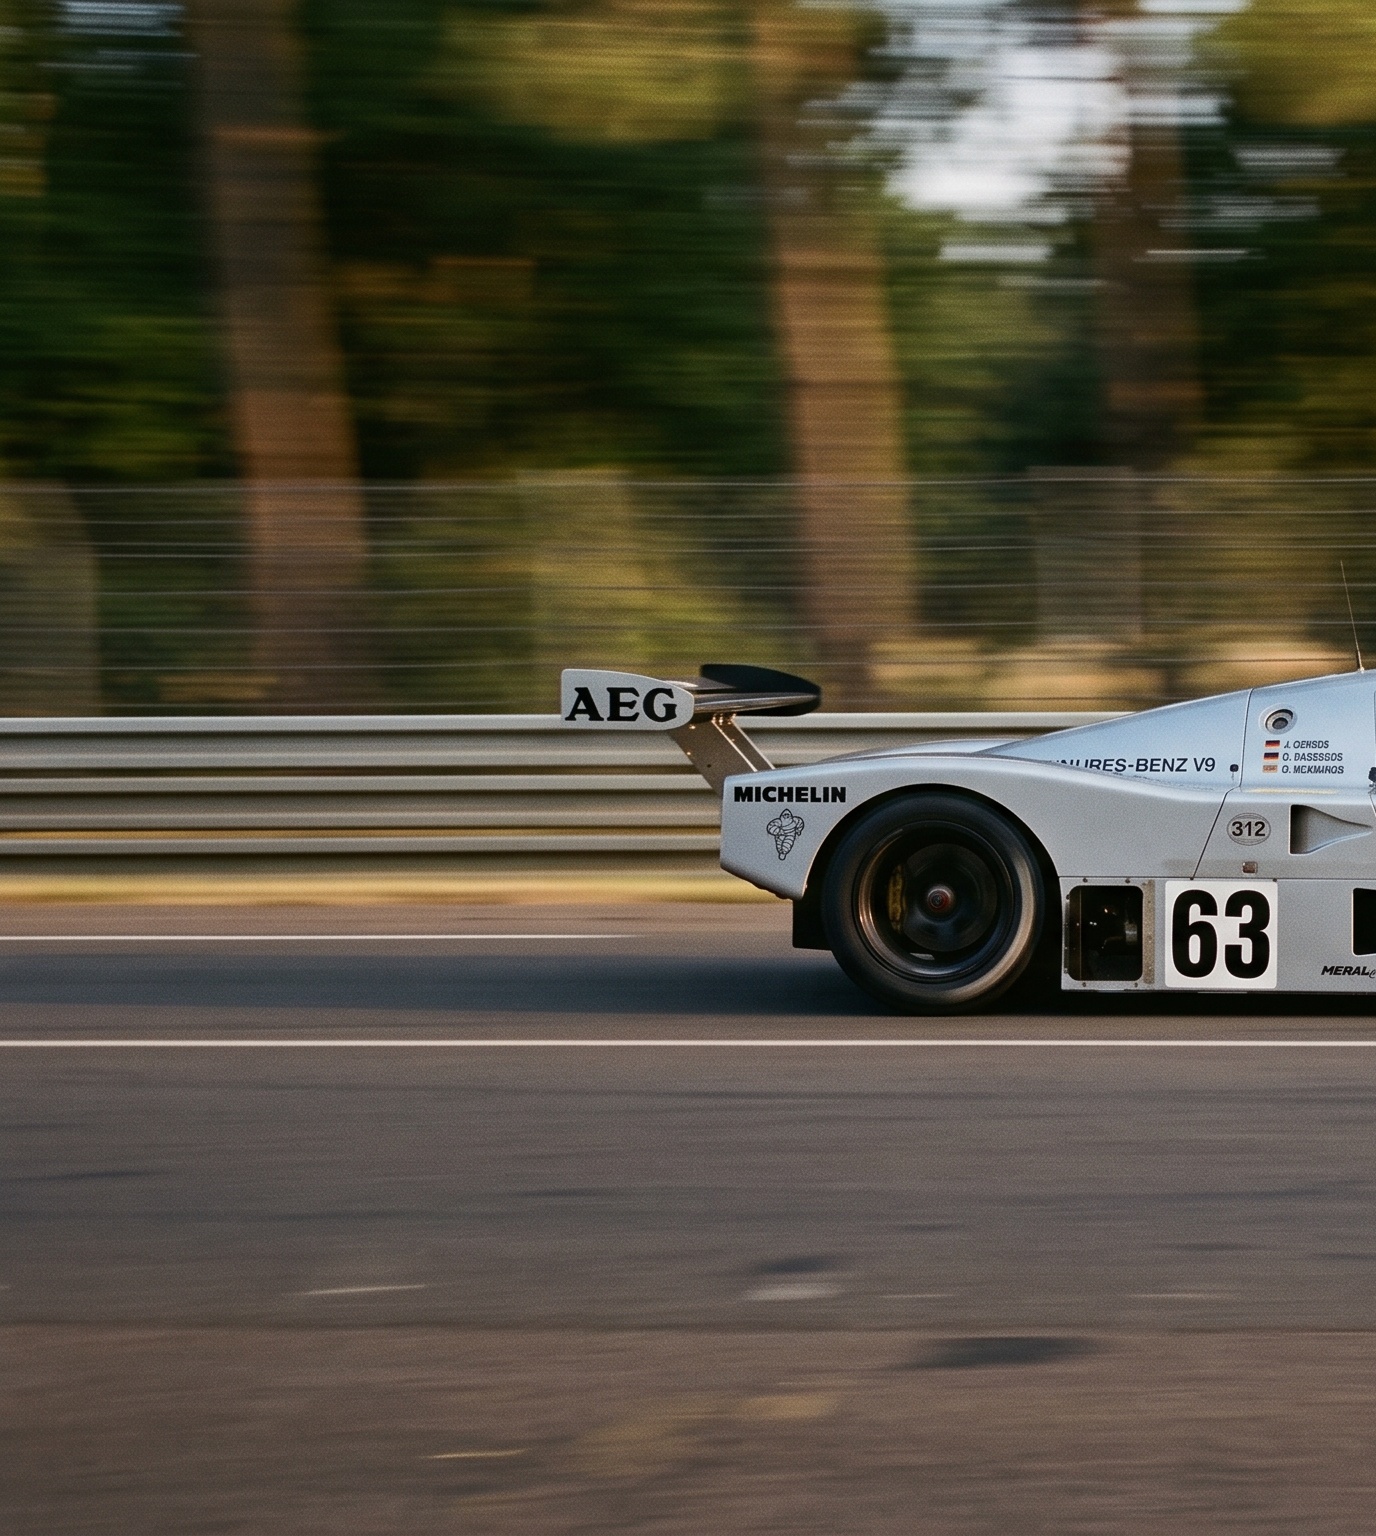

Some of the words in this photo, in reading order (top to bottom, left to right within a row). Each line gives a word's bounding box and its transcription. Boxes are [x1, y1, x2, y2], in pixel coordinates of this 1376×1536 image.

[564, 686, 678, 723] AEG
[1193, 757, 1216, 772] V9
[733, 786, 847, 803] MICHELIN
[1231, 821, 1266, 837] 312
[1172, 889, 1270, 979] 63
[1320, 965, 1370, 976] MERAL
